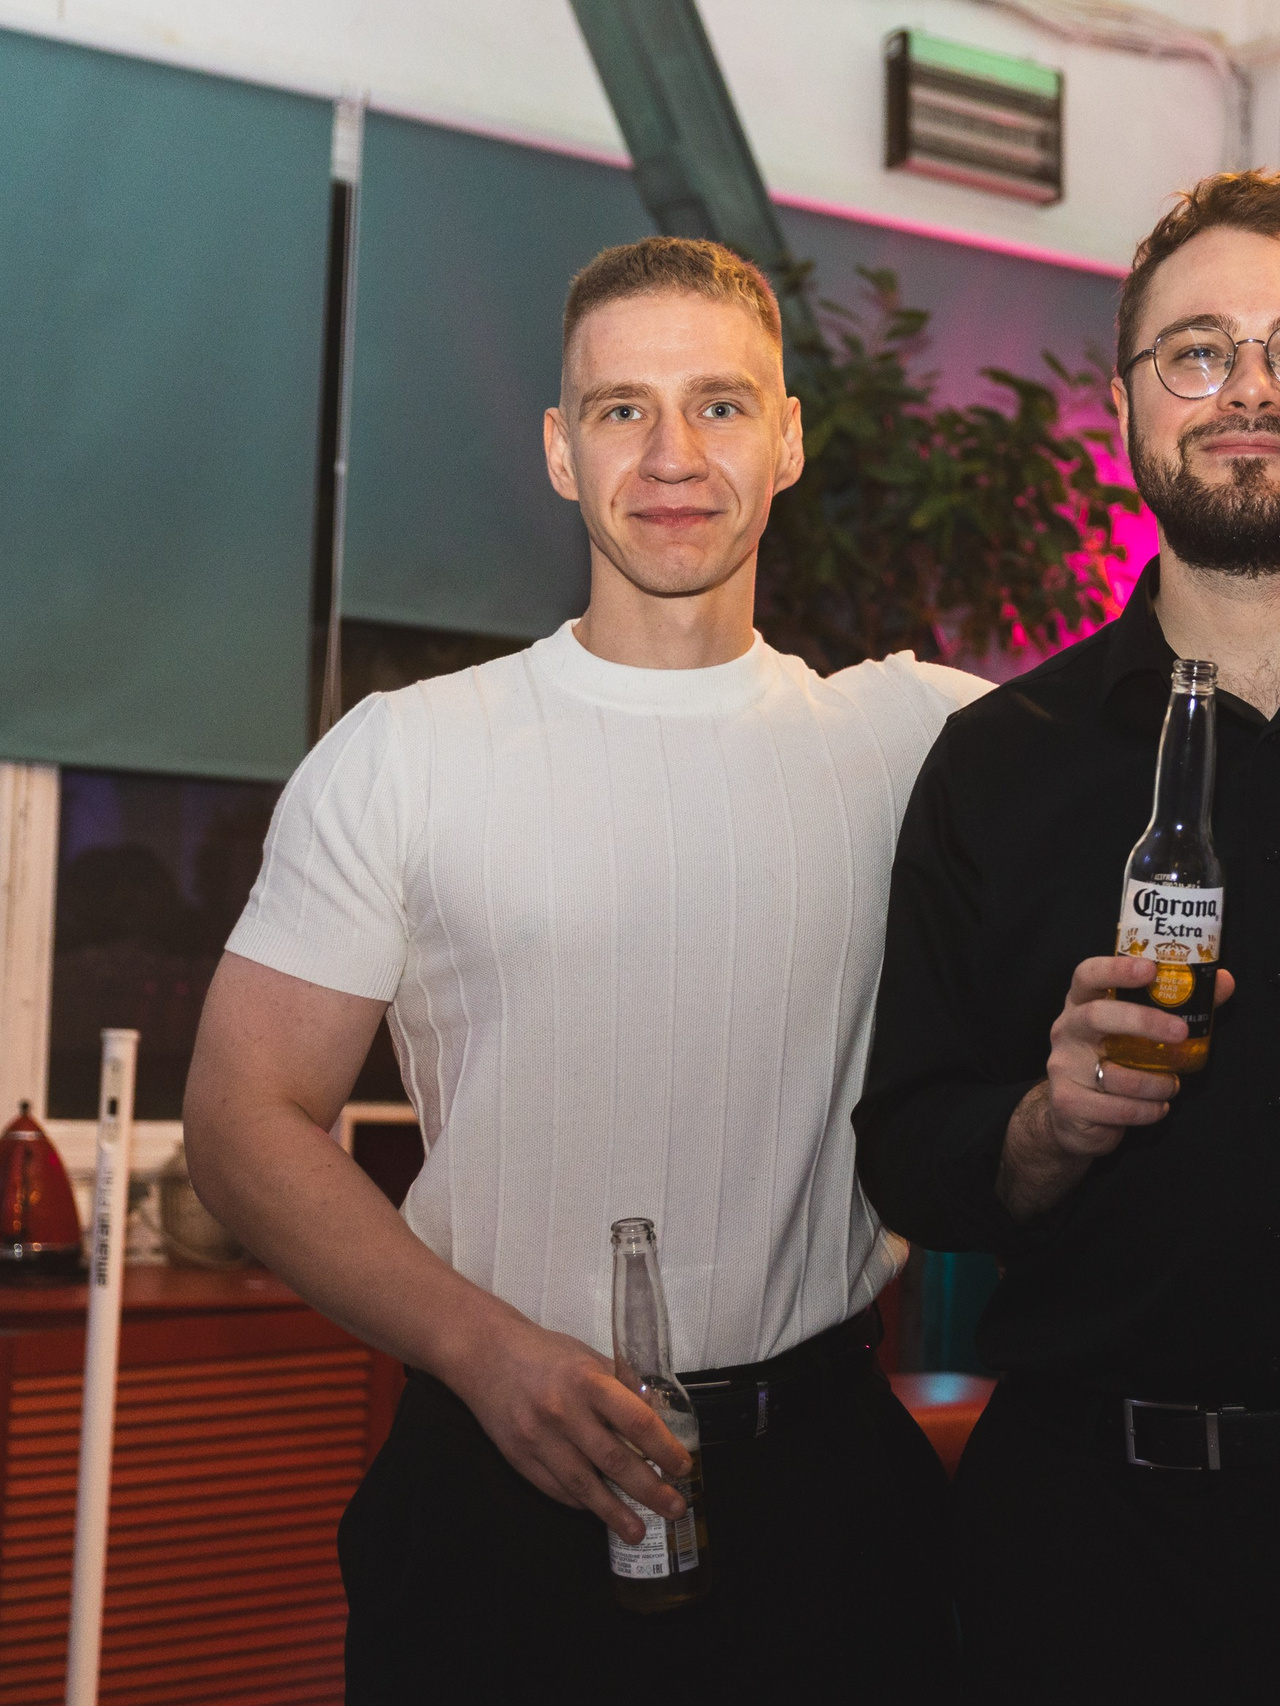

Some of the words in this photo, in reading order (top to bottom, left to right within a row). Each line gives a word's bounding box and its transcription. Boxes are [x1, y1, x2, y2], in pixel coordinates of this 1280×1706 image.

[1133, 888, 1217, 920] Corona
[1154, 917, 1203, 938] Extra
[1156, 976, 1189, 985] ERVEZA
